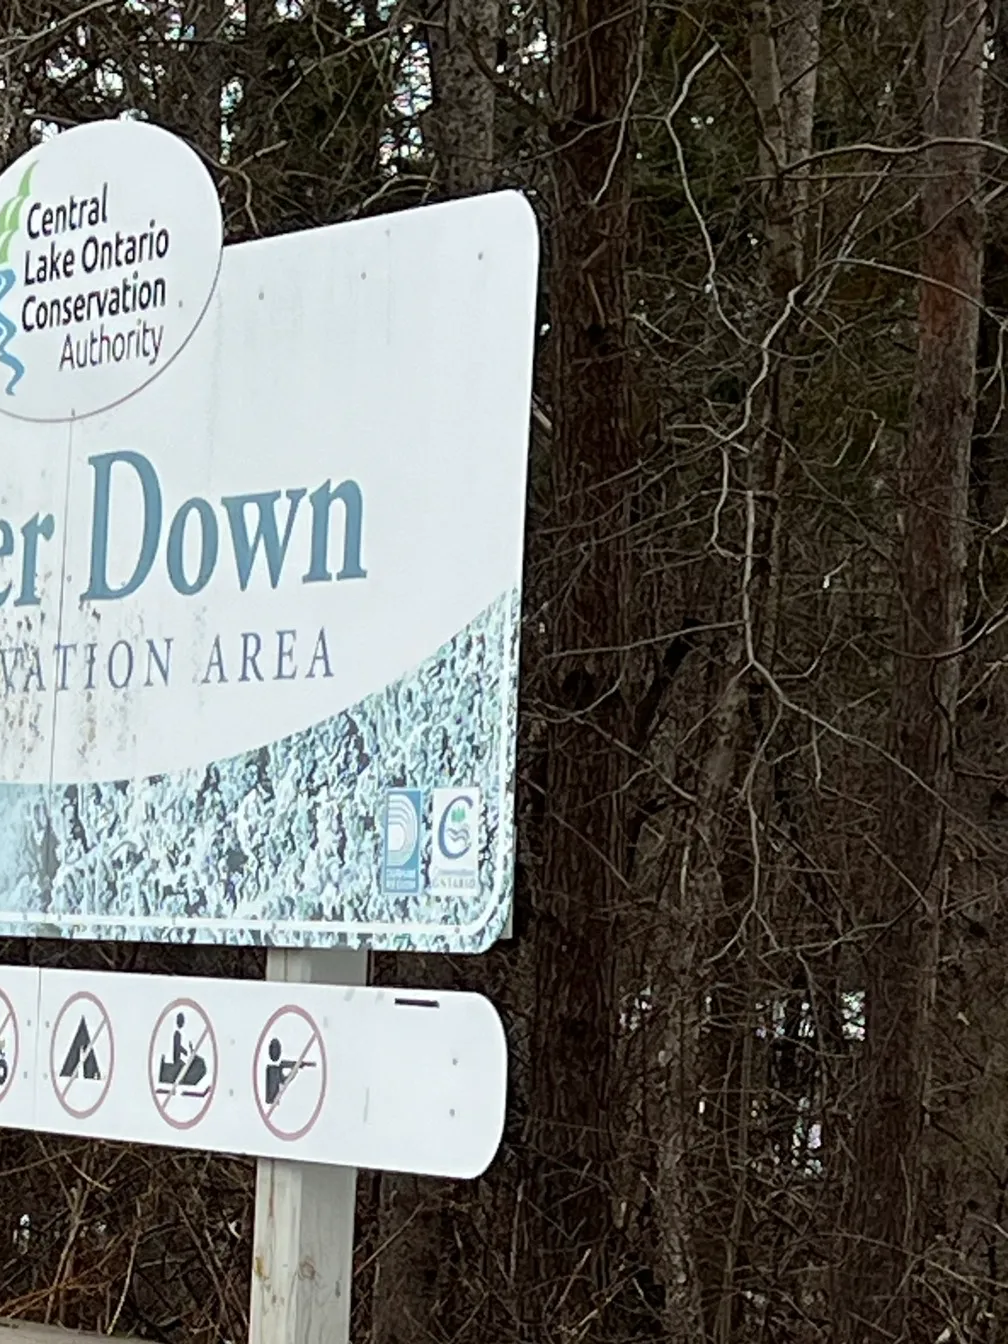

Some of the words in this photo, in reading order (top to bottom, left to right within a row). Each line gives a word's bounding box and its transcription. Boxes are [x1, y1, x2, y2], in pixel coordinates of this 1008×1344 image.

[26, 182, 108, 240] Central
[24, 241, 75, 286] Lake
[81, 218, 170, 273] Ontario
[21, 271, 167, 332] Conservation
[58, 319, 164, 371] Authority
[79, 449, 369, 602] Down
[201, 625, 334, 686] AREA
